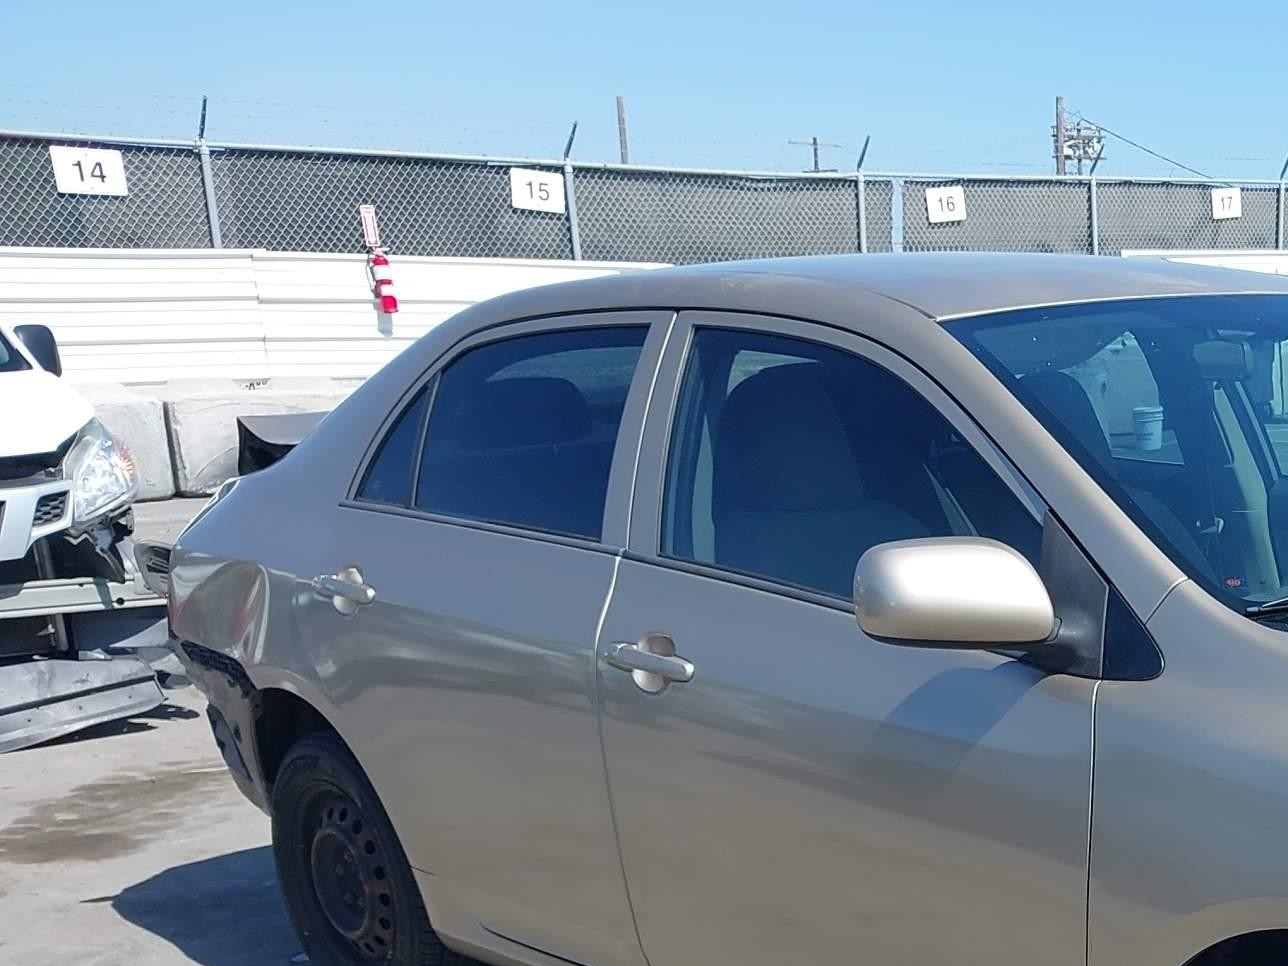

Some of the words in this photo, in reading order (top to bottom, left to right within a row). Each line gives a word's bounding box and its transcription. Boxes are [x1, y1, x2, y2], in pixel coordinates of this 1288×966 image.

[72, 160, 106, 183] 14
[525, 181, 550, 201] 15
[938, 196, 956, 212] 16
[1221, 196, 1232, 210] 17
